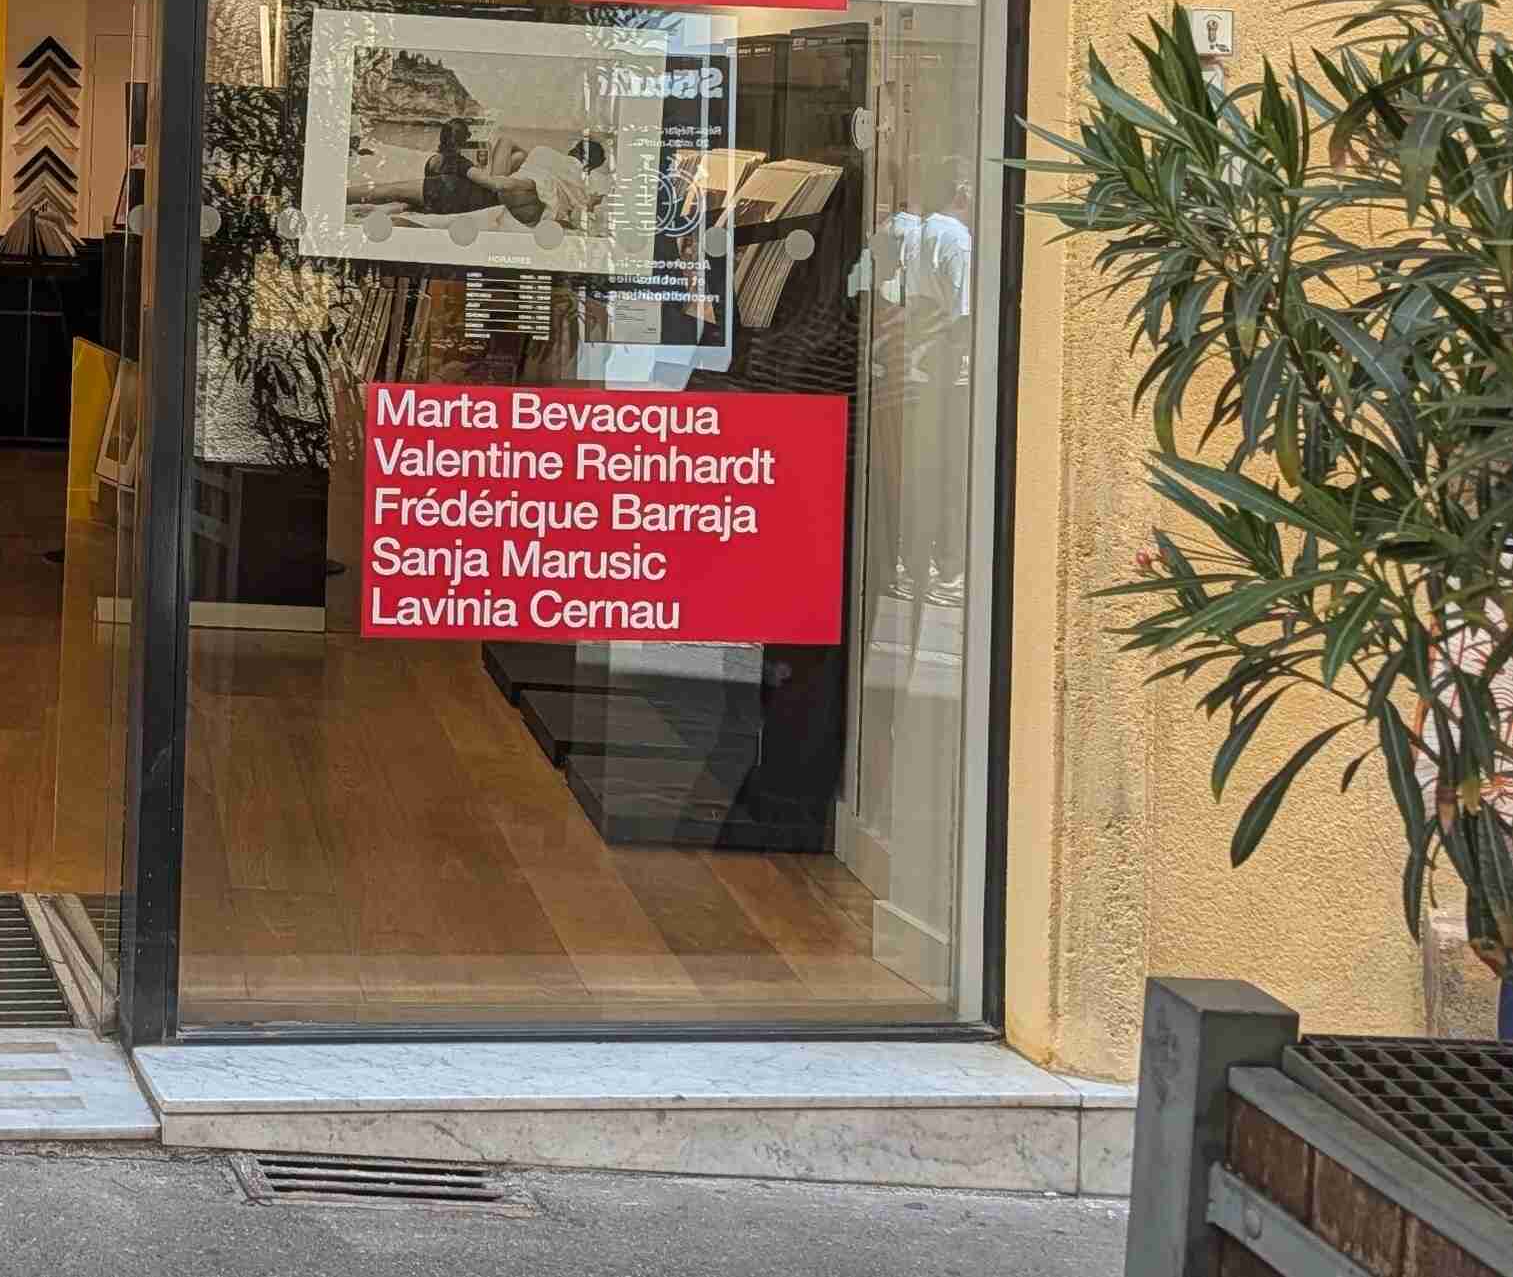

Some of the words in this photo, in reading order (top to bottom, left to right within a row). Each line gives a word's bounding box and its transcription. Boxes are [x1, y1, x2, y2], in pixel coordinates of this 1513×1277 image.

[377, 388, 499, 429] Marta
[511, 392, 721, 443] Bevacqua
[374, 438, 564, 480] Valentine
[576, 443, 775, 485] Reinhardt
[375, 487, 599, 538] Frédérique
[612, 493, 758, 542] Barraja
[372, 536, 490, 586] Sanja
[502, 540, 667, 581] Marusic
[372, 587, 518, 627] Lavinia
[530, 589, 680, 630] Cernau
